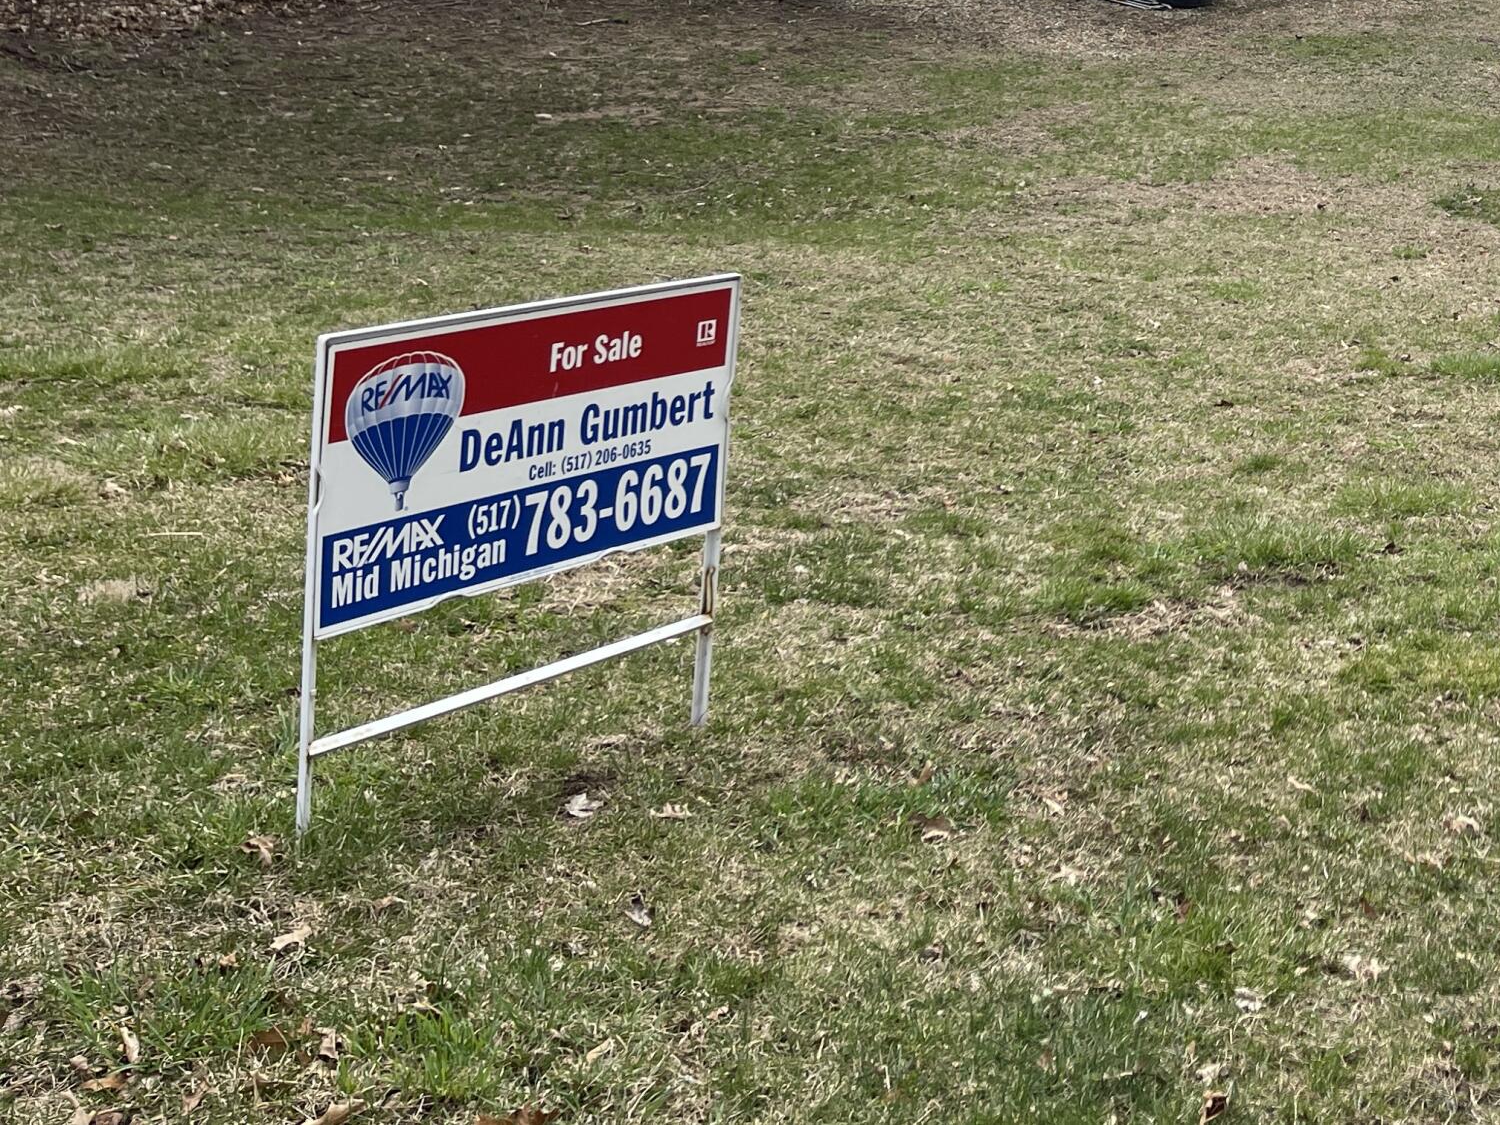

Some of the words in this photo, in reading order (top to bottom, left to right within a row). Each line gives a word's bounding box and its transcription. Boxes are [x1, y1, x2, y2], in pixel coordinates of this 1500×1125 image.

[549, 341, 588, 373] For
[593, 331, 642, 364] Sale
[361, 372, 452, 415] RE/MAX
[459, 418, 566, 473] DeAnn
[580, 381, 715, 446] Gumbert
[529, 462, 556, 481] Cell:
[561, 453, 592, 475] (517)
[595, 439, 651, 466] 206-0635
[467, 494, 521, 539] (517)
[525, 452, 712, 556] 783-6687
[331, 565, 379, 609] Mid
[390, 539, 506, 593] Michigan
